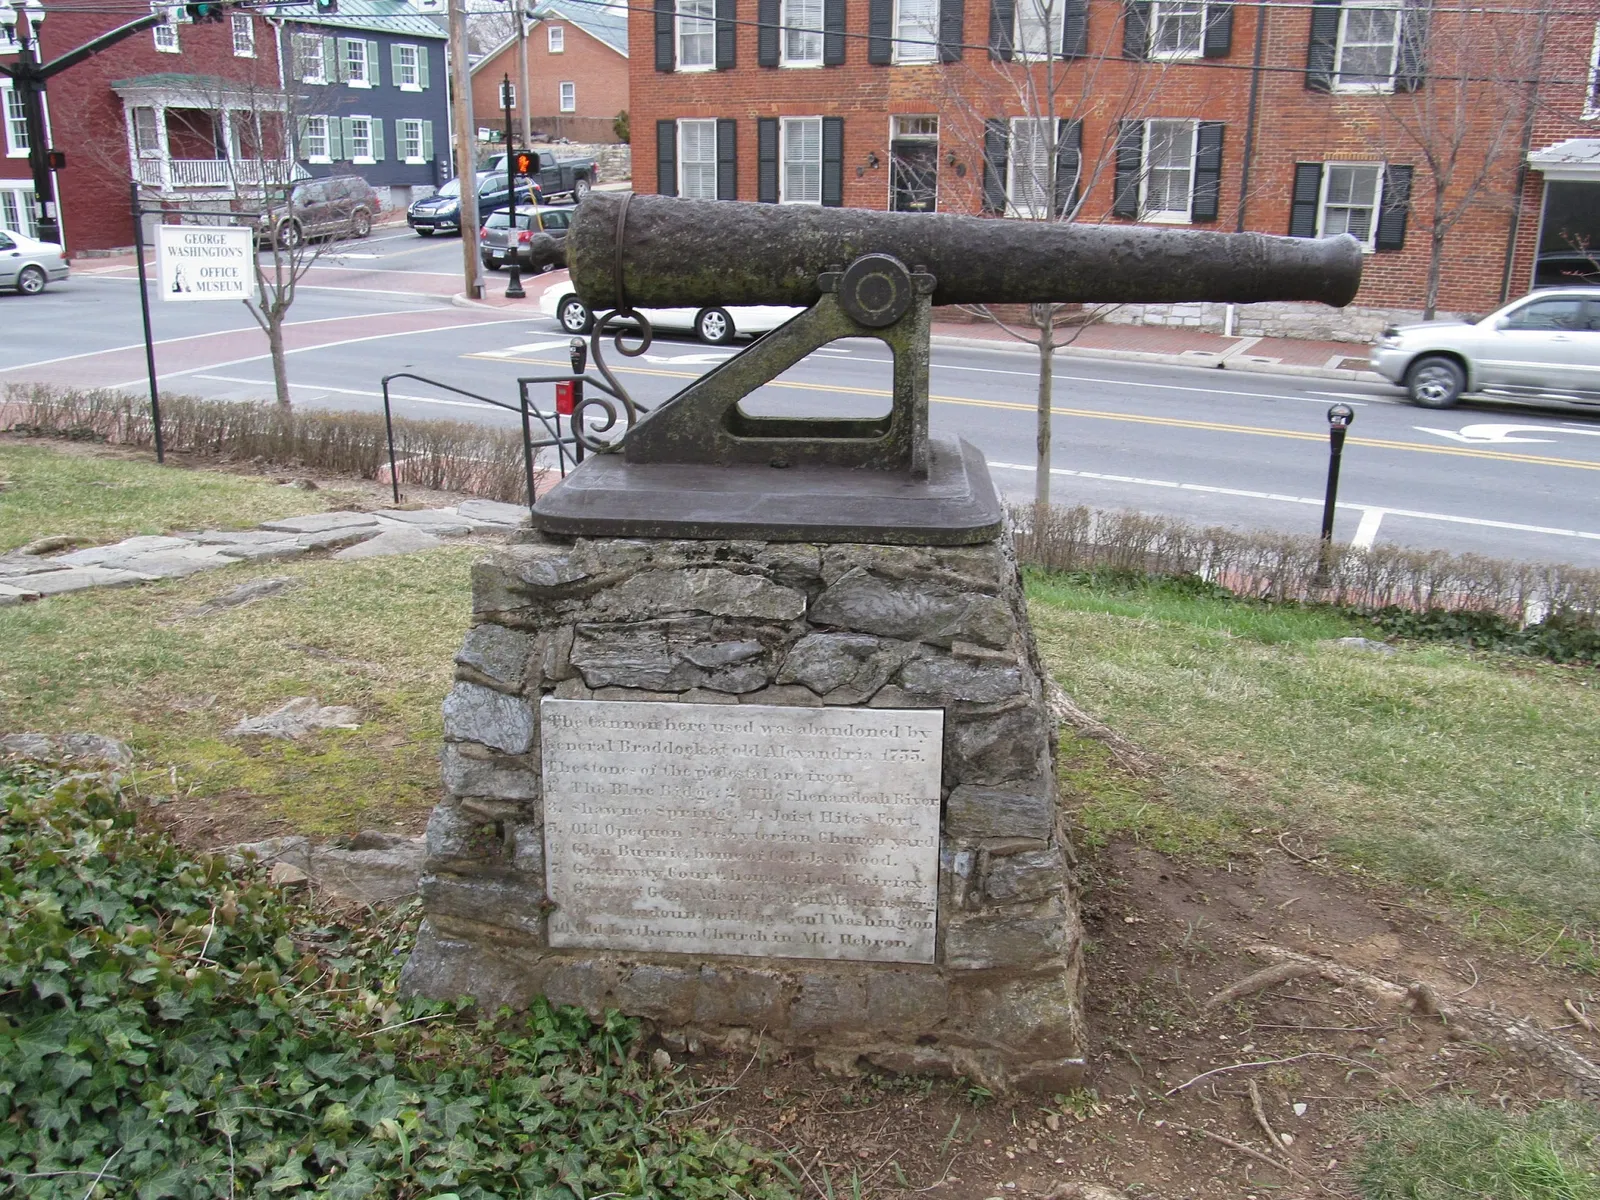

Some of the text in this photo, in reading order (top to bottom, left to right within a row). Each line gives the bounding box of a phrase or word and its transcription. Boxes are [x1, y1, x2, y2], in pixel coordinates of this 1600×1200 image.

[184, 233, 227, 245] GEORGE
[168, 246, 243, 257] WASHINGTON'S
[200, 267, 239, 278] OFFICE
[196, 281, 243, 292] MUSEUM
[548, 714, 933, 744] The Cannon here used was abandoned by
[545, 737, 612, 753] General
[617, 738, 708, 756] Braddock
[709, 743, 727, 757] at
[733, 744, 760, 757] old
[764, 744, 873, 761] Alexandria
[545, 760, 853, 783] The stones of the pedestal are from
[571, 781, 605, 795] The
[608, 782, 655, 797] Blue
[785, 787, 889, 804] Shenandoah
[571, 802, 650, 816] Shawnee
[768, 809, 813, 822] Joist
[571, 822, 600, 836] Old
[605, 823, 681, 840] Opequon
[693, 846, 743, 860] home
[747, 850, 765, 862] of
[572, 862, 664, 882] Greenway
[829, 911, 934, 933] Washington
[605, 923, 698, 938] Lutheran
[701, 927, 768, 941] Church
[772, 931, 792, 943] in
